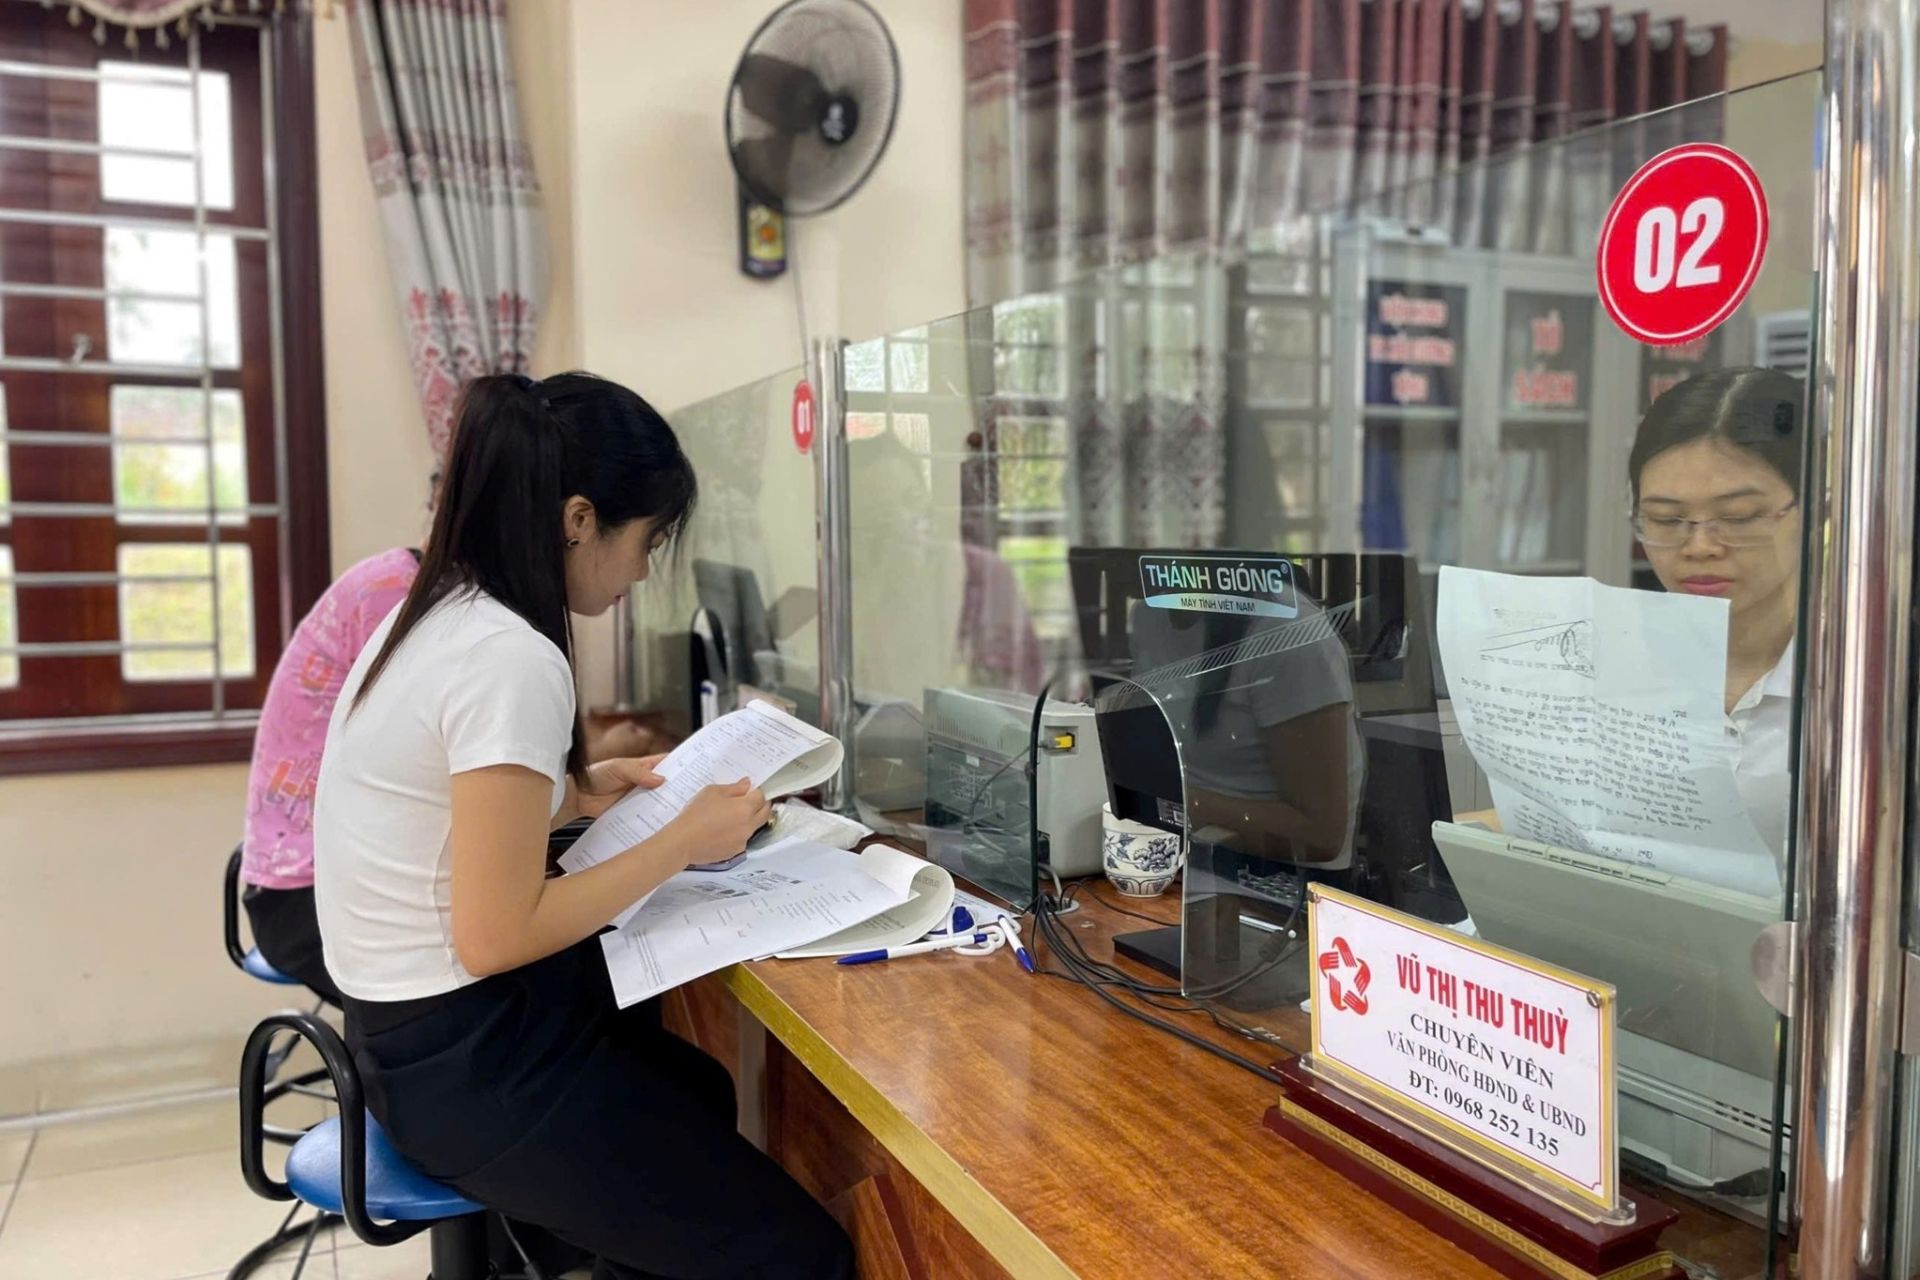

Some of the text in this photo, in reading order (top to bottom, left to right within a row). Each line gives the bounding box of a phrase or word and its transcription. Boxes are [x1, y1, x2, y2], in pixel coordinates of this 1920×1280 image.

[1633, 196, 1725, 294] 02
[797, 398, 811, 434] 01
[1145, 560, 1212, 590] THÁNH
[1180, 596, 1197, 608] MÁY
[1199, 596, 1217, 610] TÍNH
[1236, 601, 1257, 613] NAM
[1396, 953, 1569, 1056] VŨ THỊ THU THUỲ
[1387, 1030, 1587, 1138] VĂN PHÒNG HĐND & UBND
[1410, 1013, 1554, 1091] CHUYÊN VIÊN
[1409, 1069, 1560, 1157] ĐT: 0968 252 135
